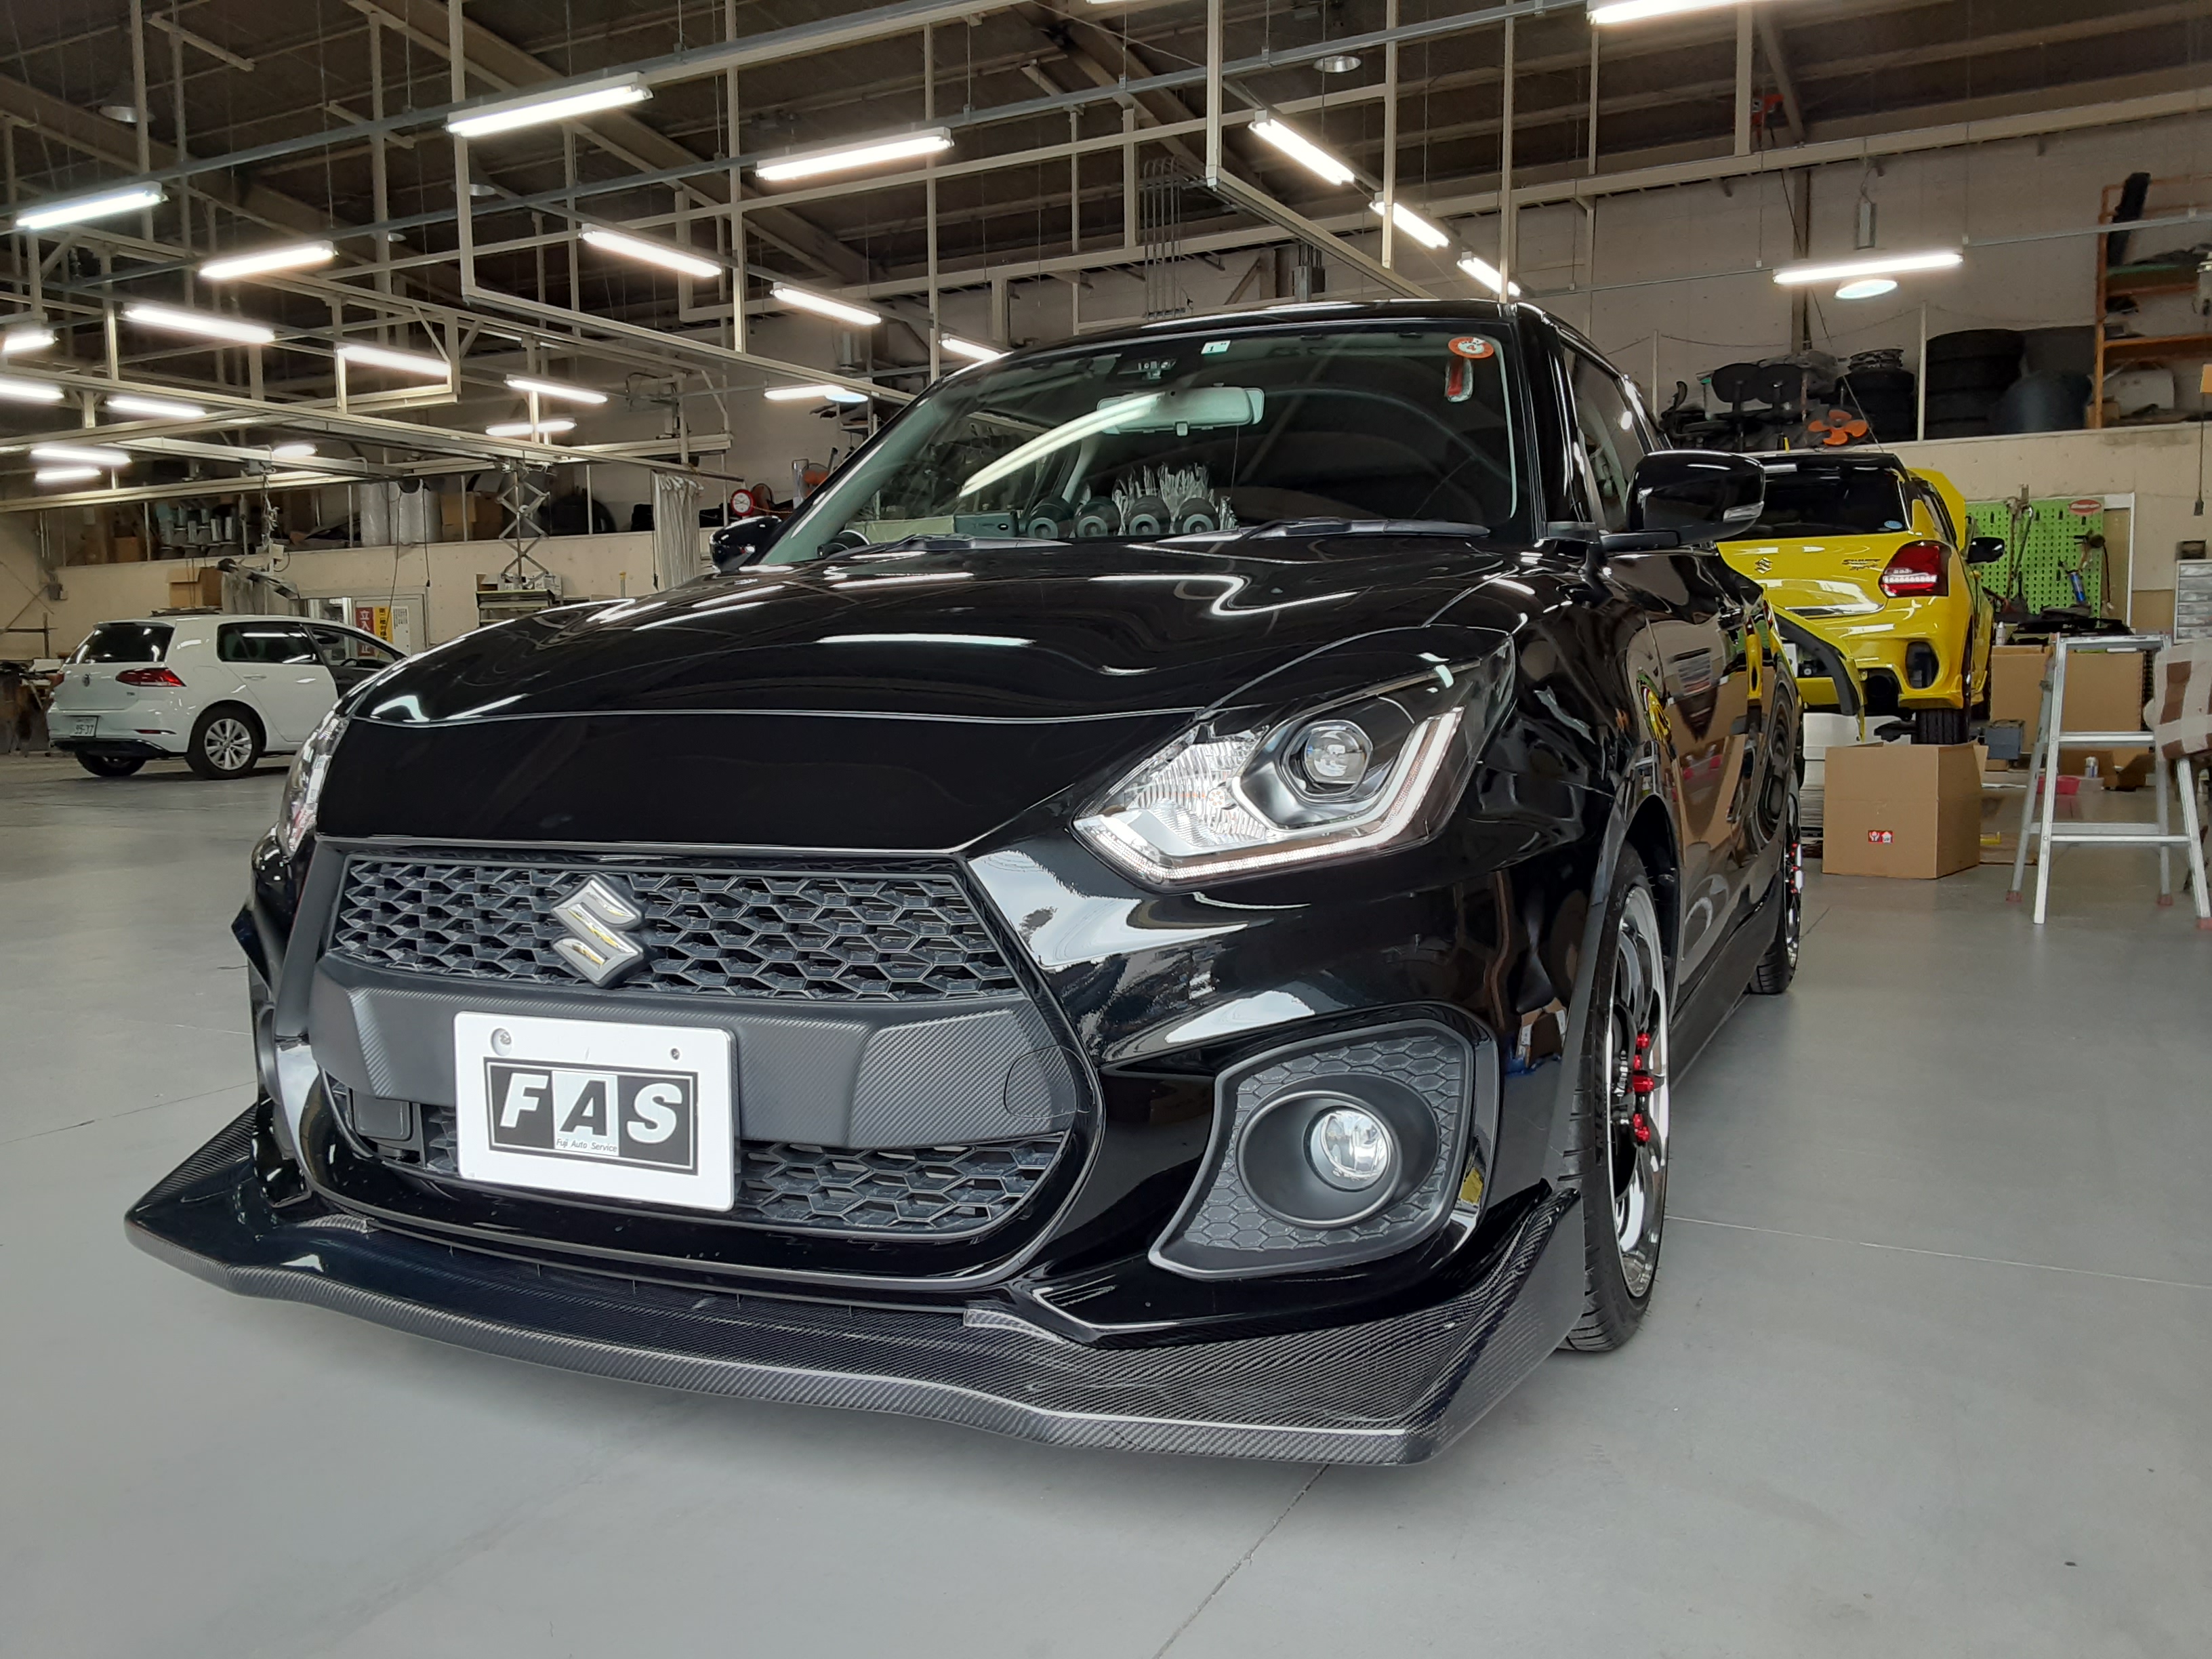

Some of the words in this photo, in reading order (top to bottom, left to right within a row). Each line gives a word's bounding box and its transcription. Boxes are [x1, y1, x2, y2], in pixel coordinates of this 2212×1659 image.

[360, 610, 371, 654] 立入止
[499, 1073, 682, 1144] FAS
[556, 1139, 569, 1148] Fuji
[571, 1140, 588, 1149] Auto
[591, 1142, 617, 1152] Service
